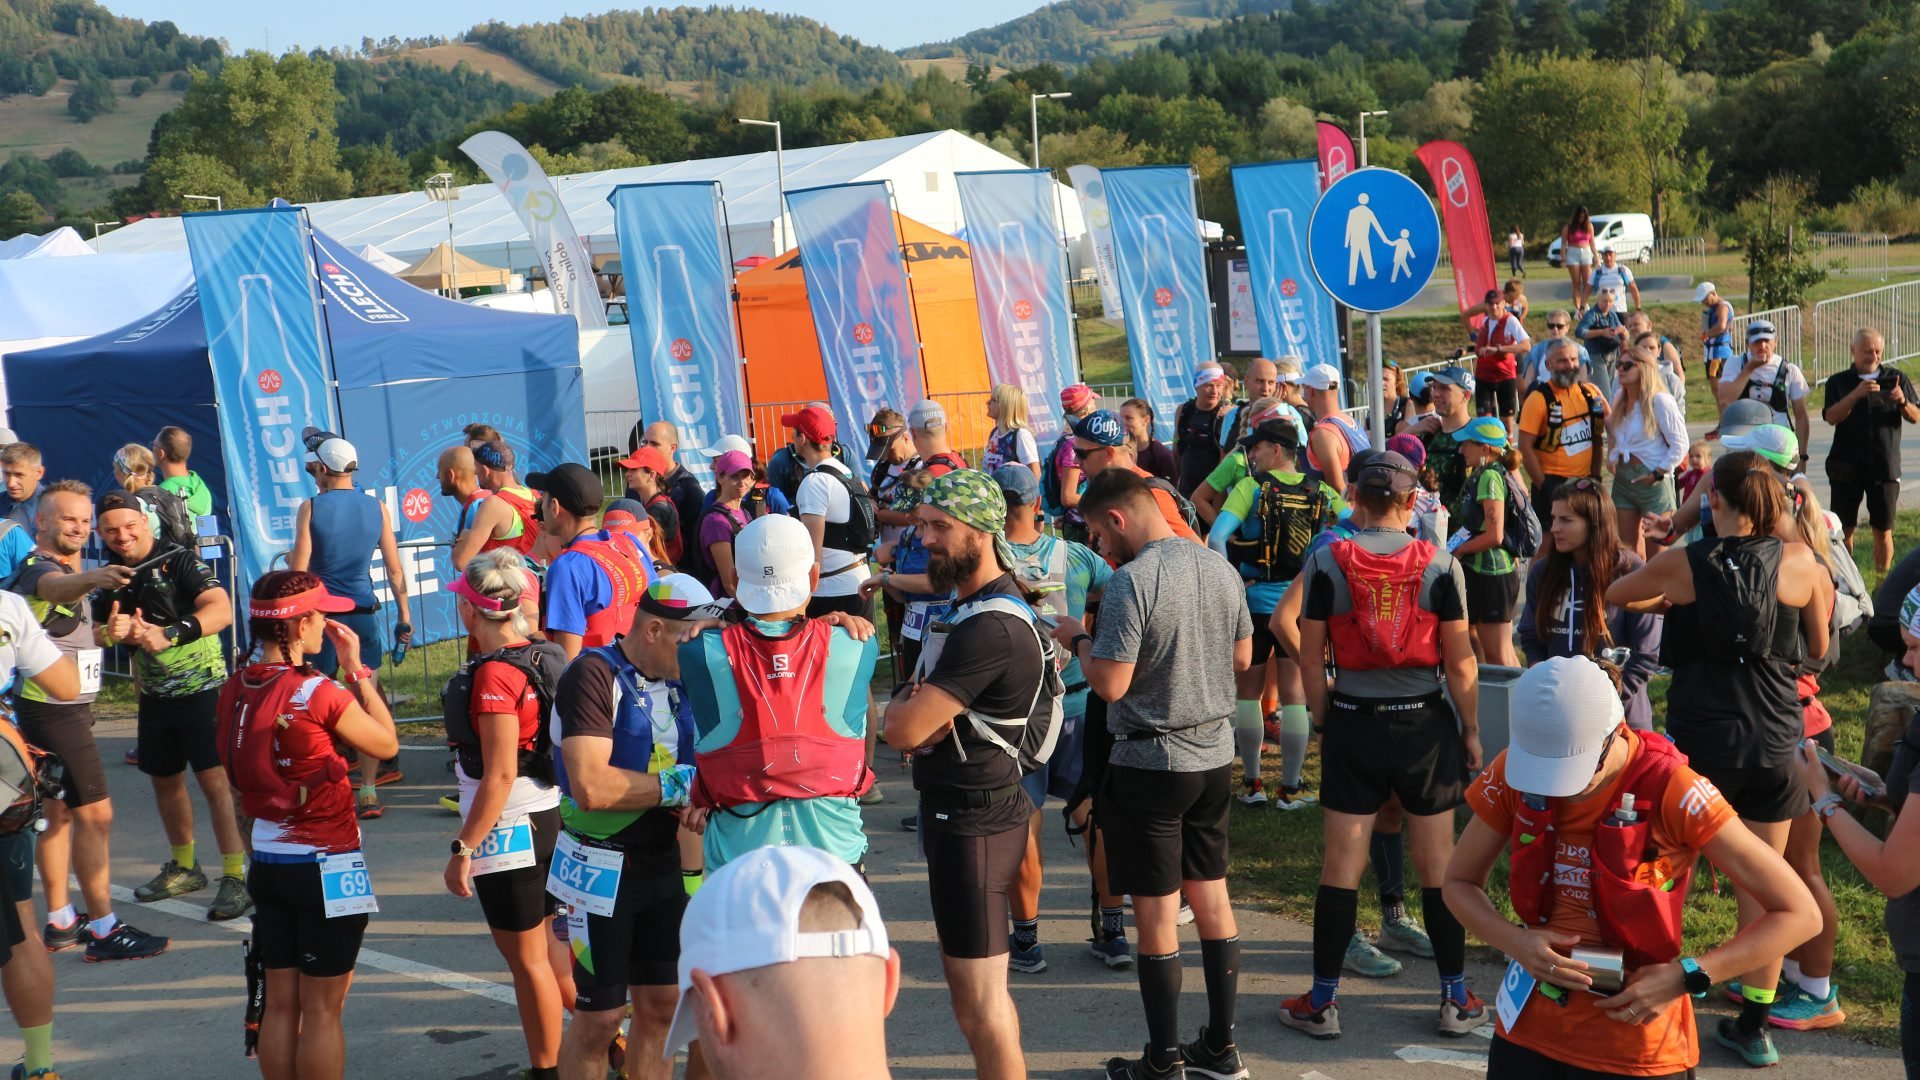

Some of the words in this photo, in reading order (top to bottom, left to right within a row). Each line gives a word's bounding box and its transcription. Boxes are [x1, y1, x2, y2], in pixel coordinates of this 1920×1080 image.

[327, 274, 387, 313] LECH
[420, 412, 525, 442] STWORZONA
[1388, 702, 1424, 711] ICEBUG
[559, 856, 602, 892] 647
